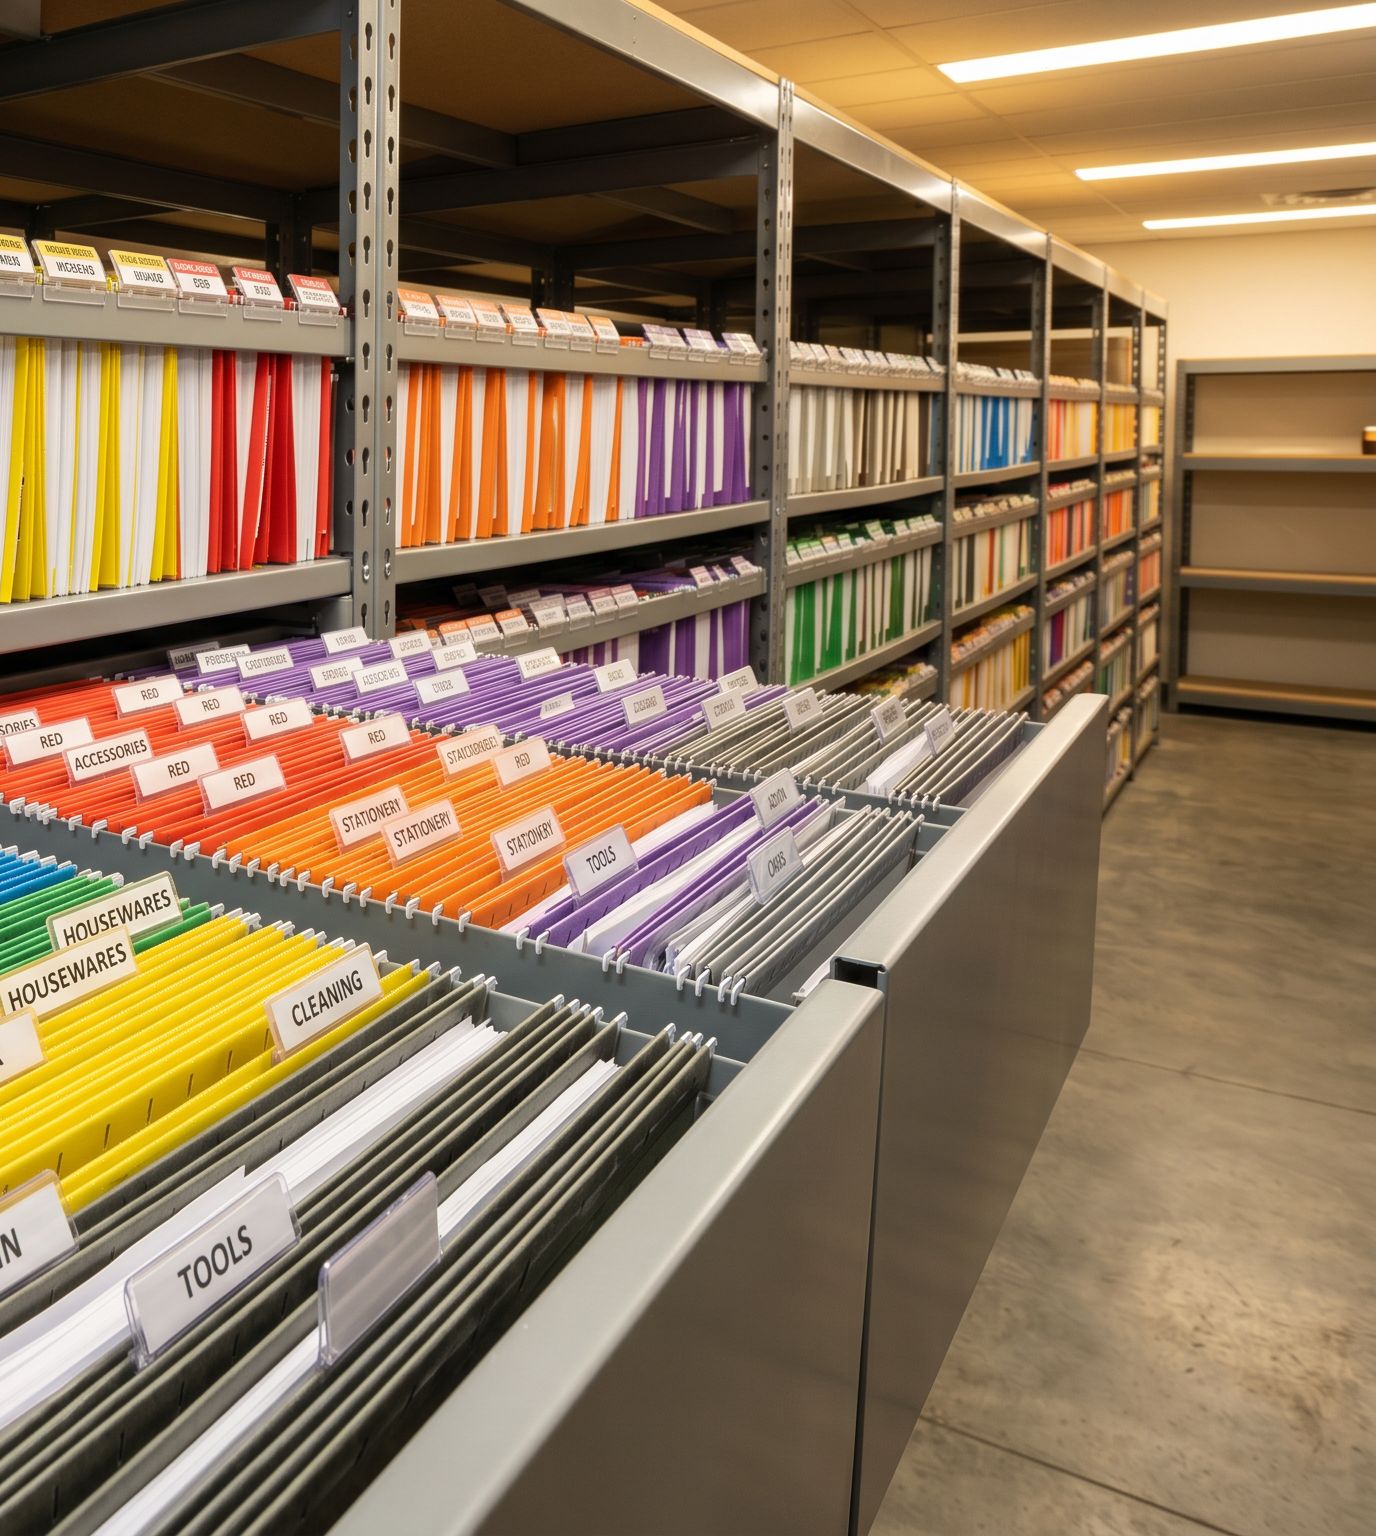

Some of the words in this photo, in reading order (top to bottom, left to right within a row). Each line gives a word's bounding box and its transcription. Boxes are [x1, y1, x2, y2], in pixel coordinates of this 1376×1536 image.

[142, 687, 159, 701] RED
[202, 698, 220, 712] RED
[269, 712, 288, 726] RED
[40, 733, 63, 749] RED
[368, 730, 386, 744] RED
[74, 739, 147, 771] ACCESSORIES
[167, 761, 190, 778] RED
[234, 772, 255, 790] RED
[342, 798, 401, 833] STATIONERY
[394, 811, 451, 848] STATIONERY
[586, 846, 616, 874] TOOLS
[63, 888, 171, 946] HOUSEWARES
[8, 942, 126, 1012] HOUSEWARES
[291, 970, 363, 1027] CLEANING
[177, 1225, 252, 1298] TOOLS
